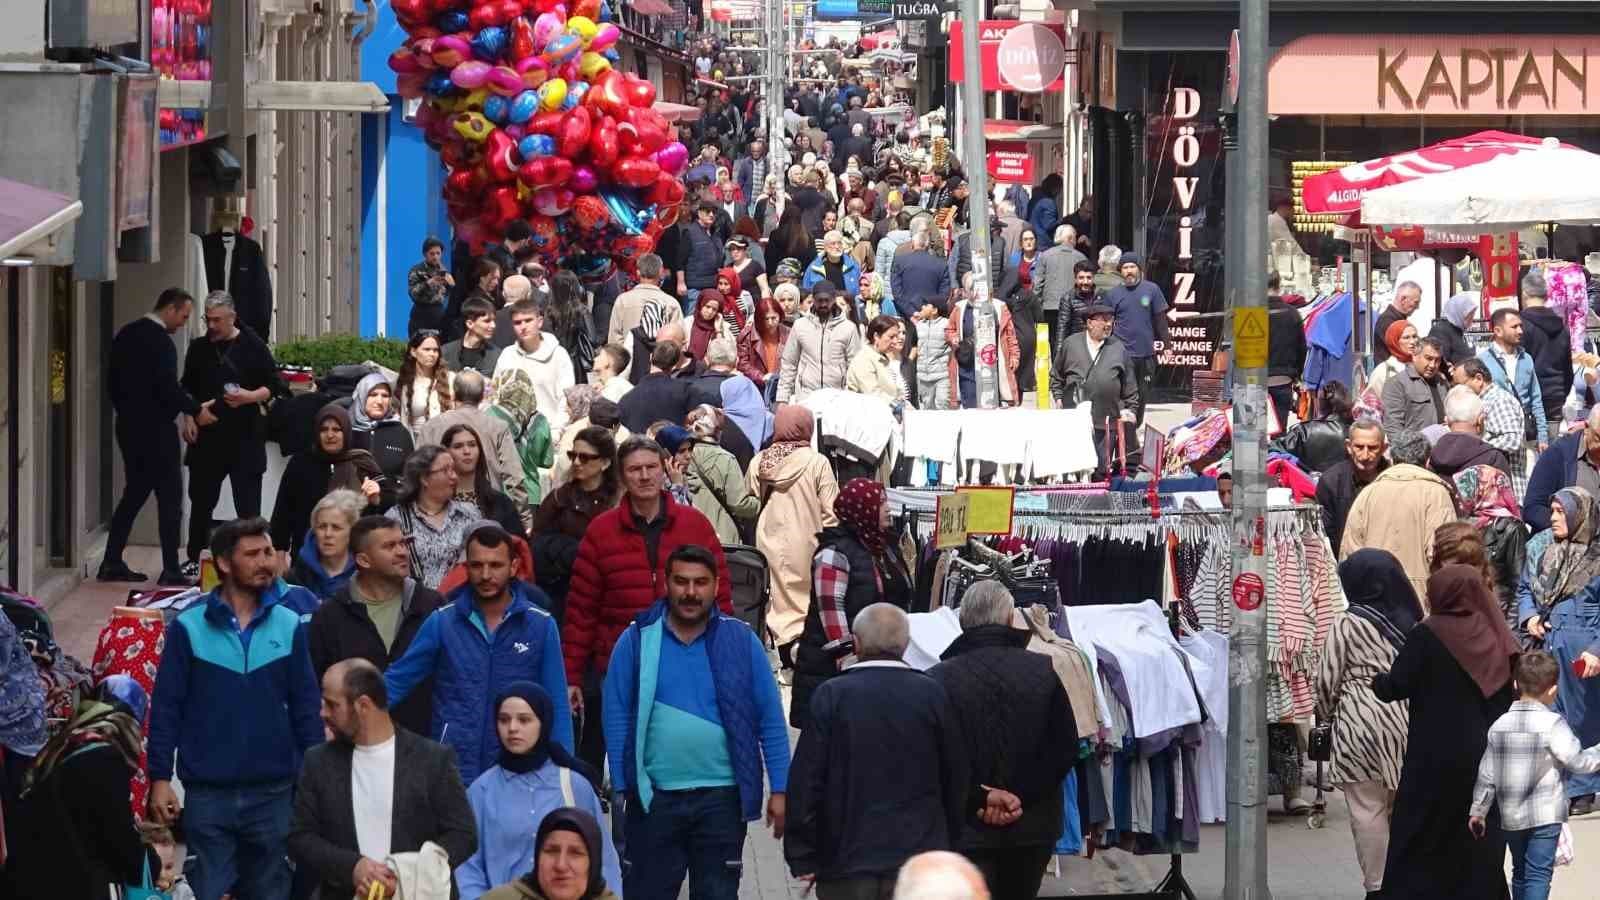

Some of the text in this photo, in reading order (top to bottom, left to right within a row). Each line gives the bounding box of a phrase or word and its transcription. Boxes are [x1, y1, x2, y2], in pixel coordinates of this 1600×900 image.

[897, 2, 939, 15] TUĞRA
[1377, 48, 1587, 110] KAPTAN
[1168, 327, 1207, 338] HANGE
[1153, 340, 1213, 352] EHANGE
[1157, 354, 1209, 366] WECHSEL
